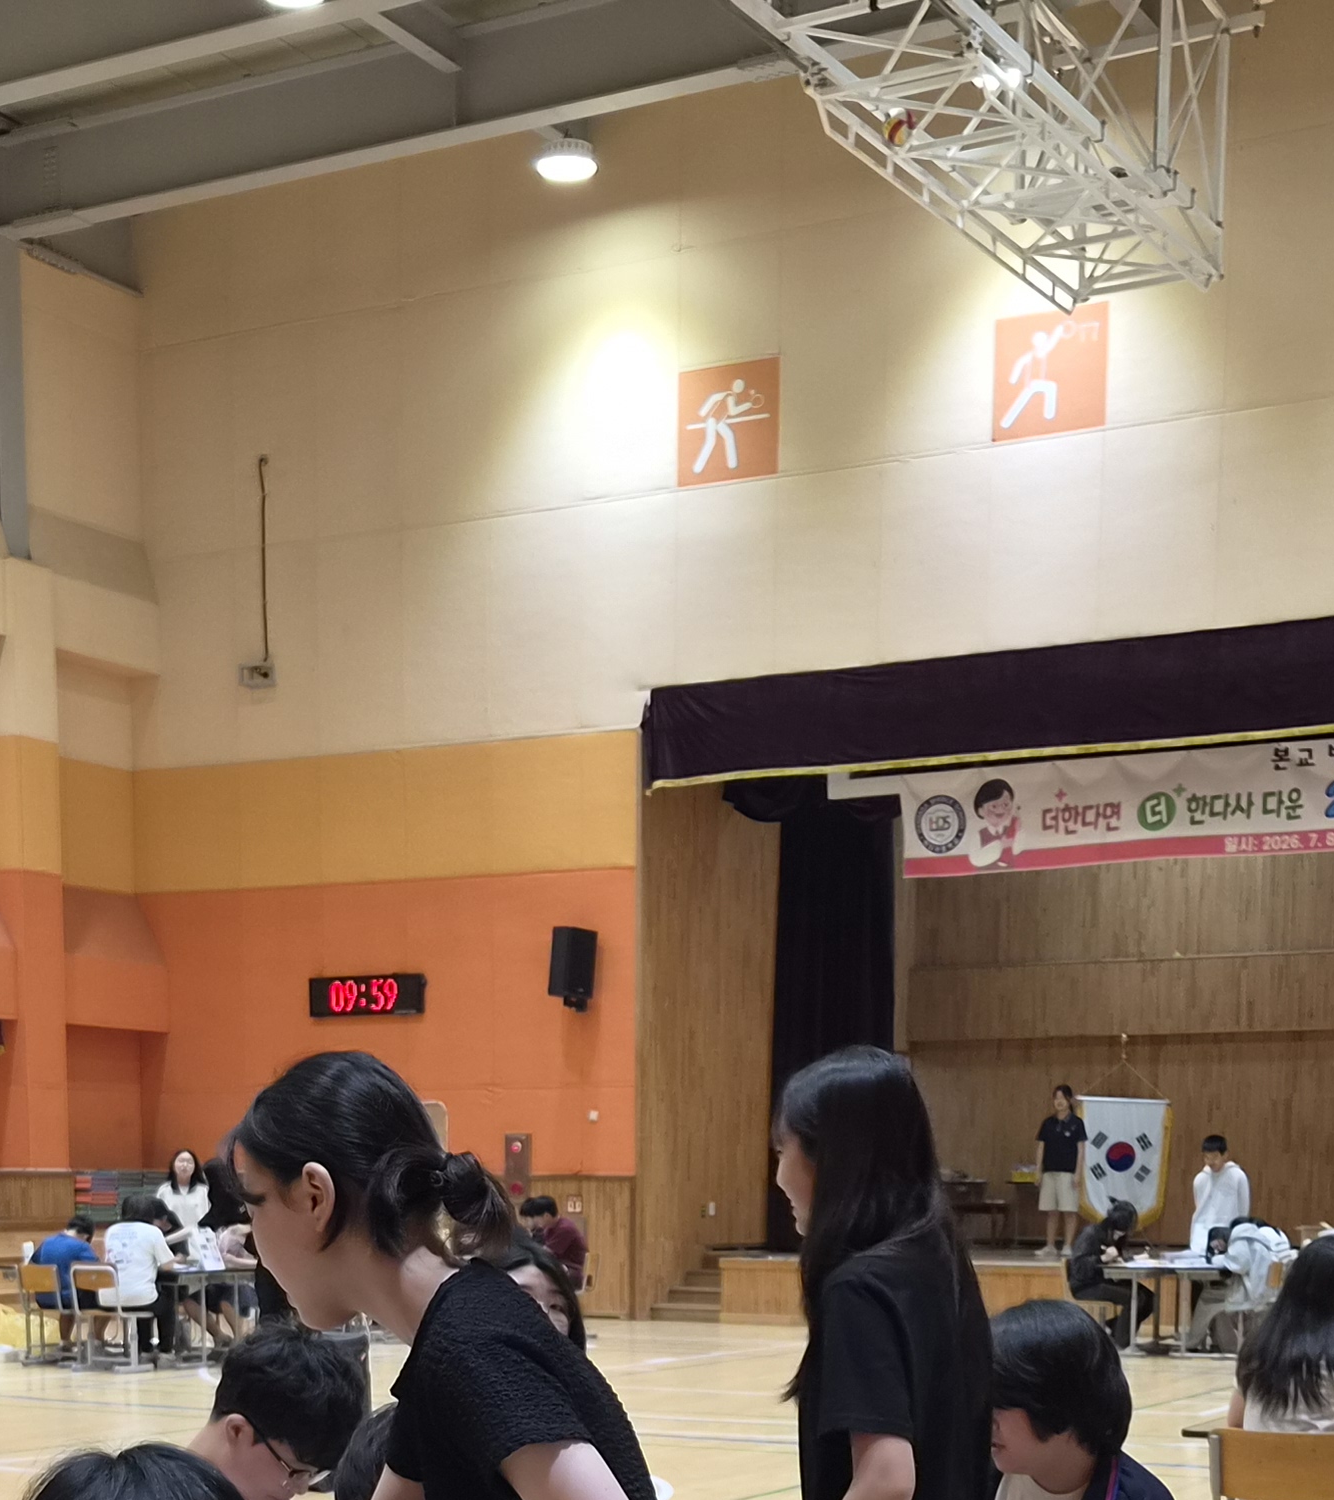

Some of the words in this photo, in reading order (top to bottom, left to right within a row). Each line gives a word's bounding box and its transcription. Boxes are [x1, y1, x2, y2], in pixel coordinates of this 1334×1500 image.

[1271, 747, 1315, 771] 본교
[1041, 800, 1122, 836] 더한다면
[1186, 792, 1255, 825] 한다사
[1262, 787, 1305, 821] 다운
[1262, 834, 1304, 851] 2026.
[1309, 833, 1322, 848] 7.
[329, 978, 398, 1012] 09:59
